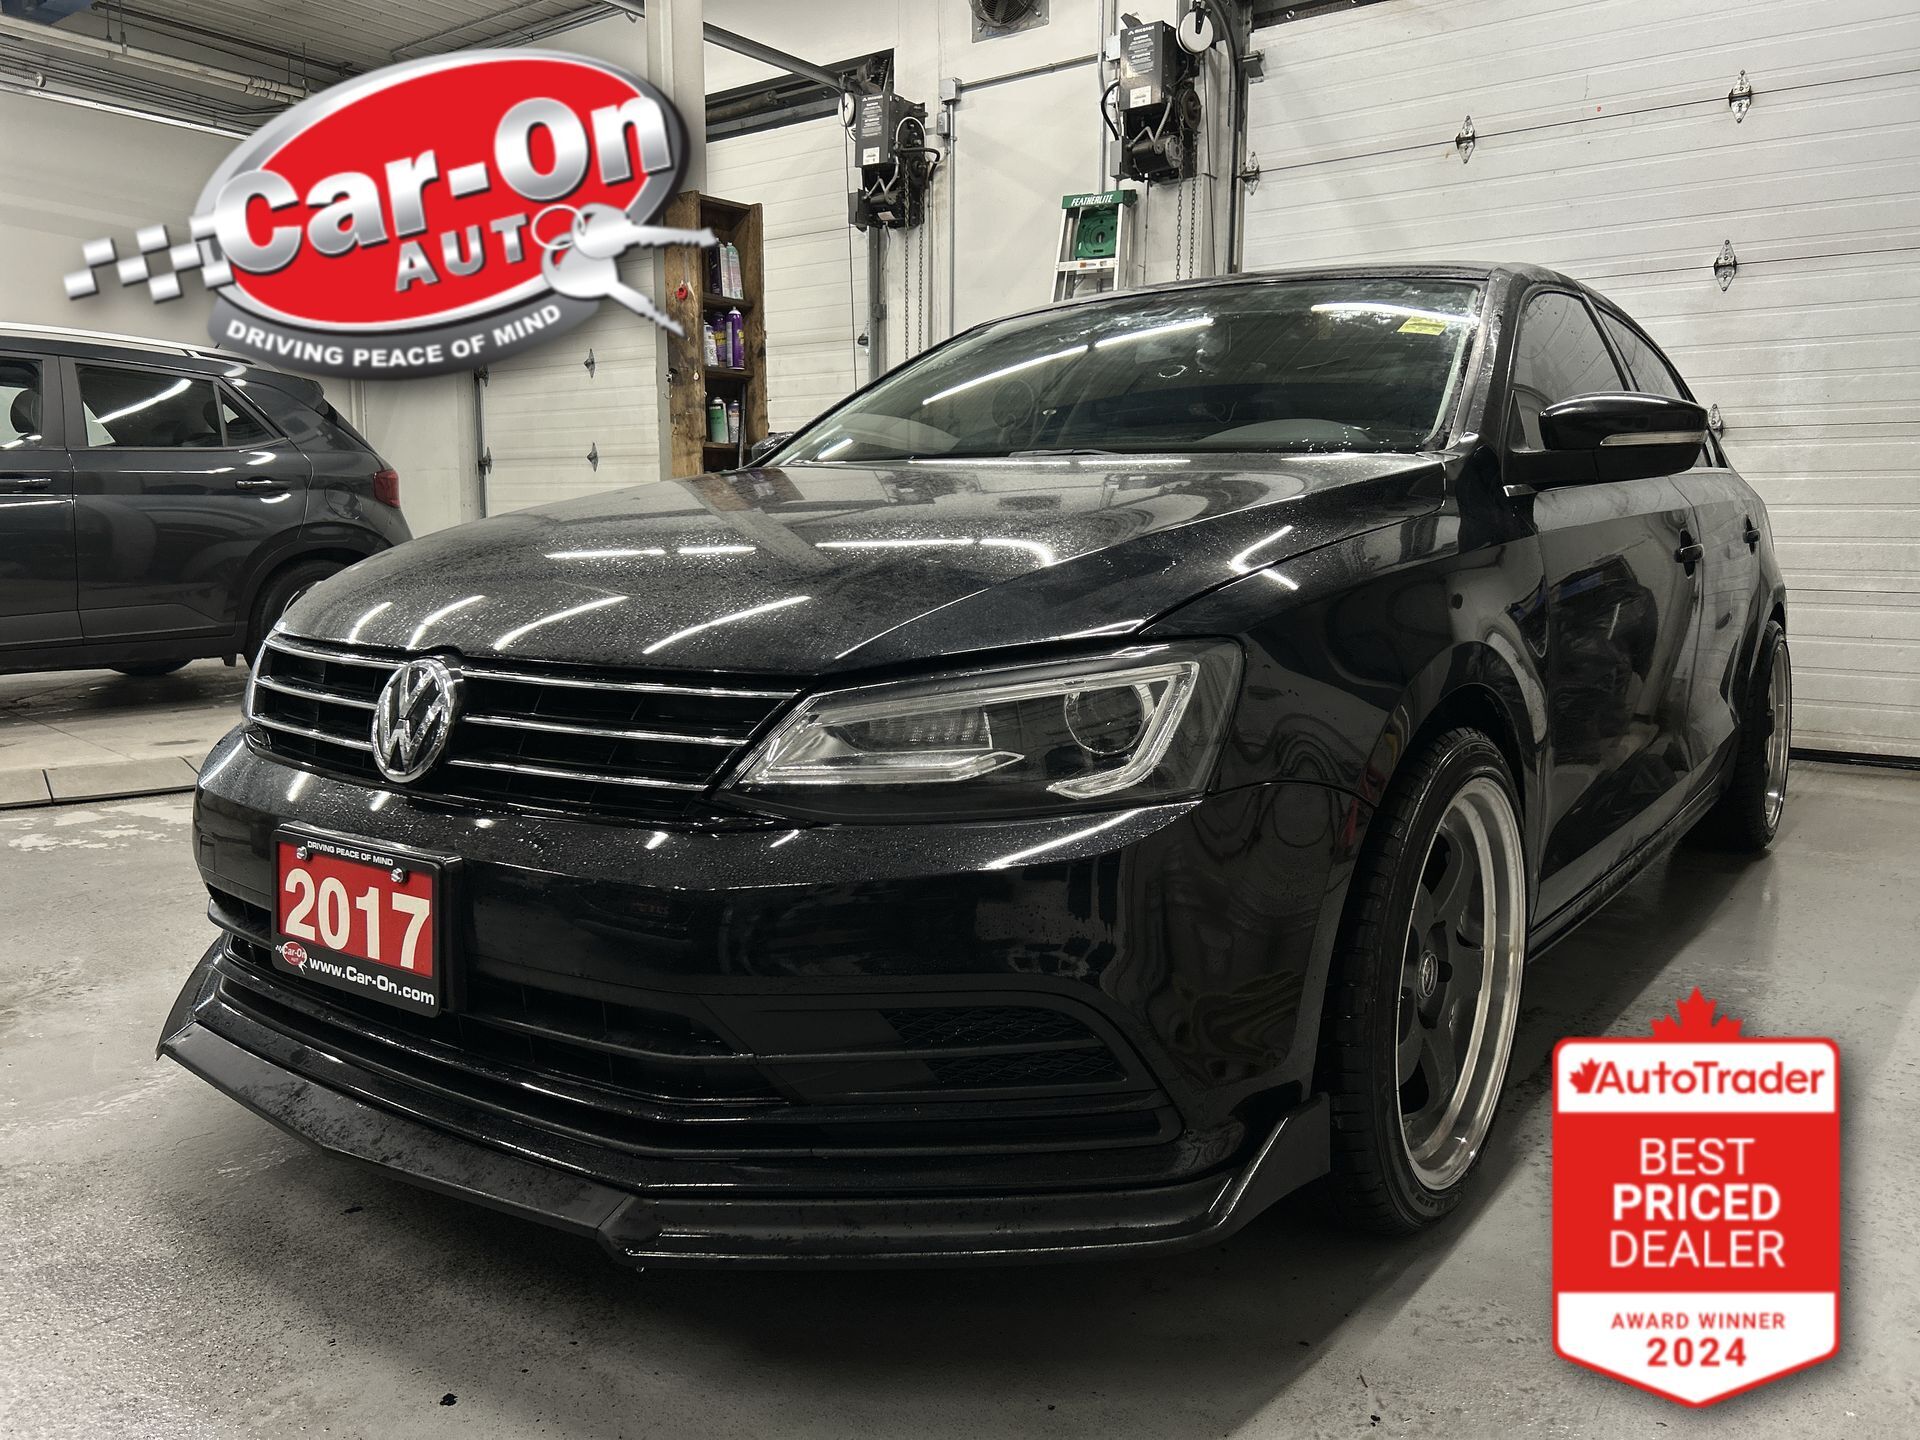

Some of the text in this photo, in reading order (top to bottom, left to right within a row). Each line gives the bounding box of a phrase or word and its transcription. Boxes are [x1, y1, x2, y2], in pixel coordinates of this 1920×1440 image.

[1071, 194, 1114, 207] FEATHERLITE
[307, 841, 394, 867] DRIVING PEACE OF MIND
[285, 868, 430, 969] 2017
[309, 958, 435, 1006] www.Car-On.com
